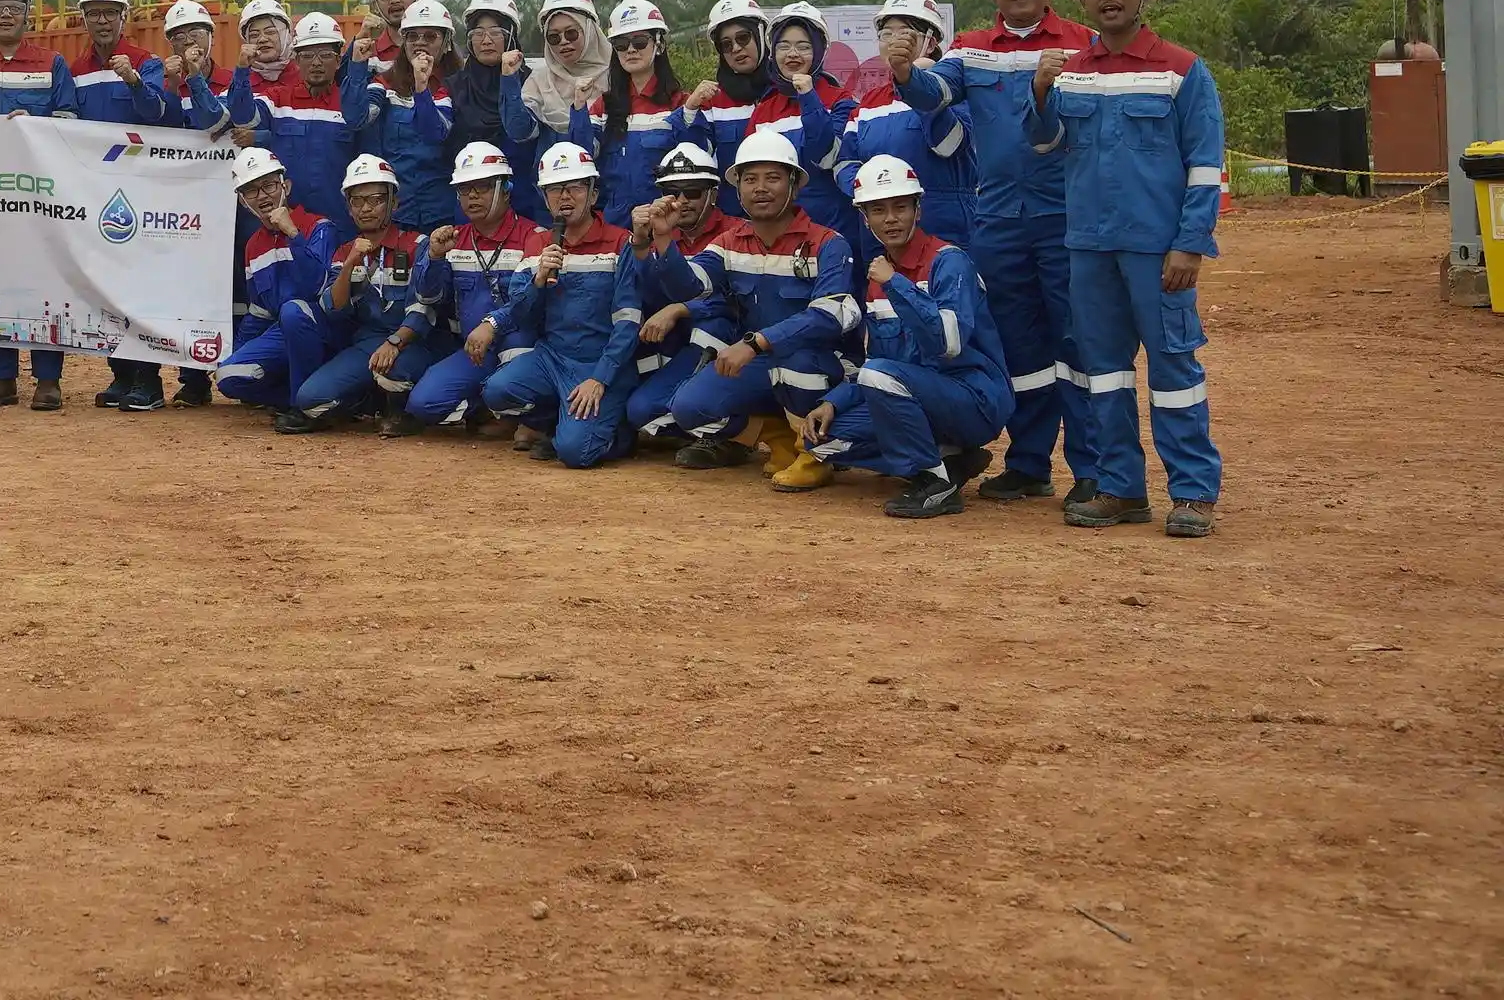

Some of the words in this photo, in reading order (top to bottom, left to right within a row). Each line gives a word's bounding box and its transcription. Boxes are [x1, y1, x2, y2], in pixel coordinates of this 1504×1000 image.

[149, 147, 236, 160] PERTAMINA
[33, 200, 87, 221] PHR24
[143, 211, 202, 230] PHR24
[196, 343, 217, 359] 35
